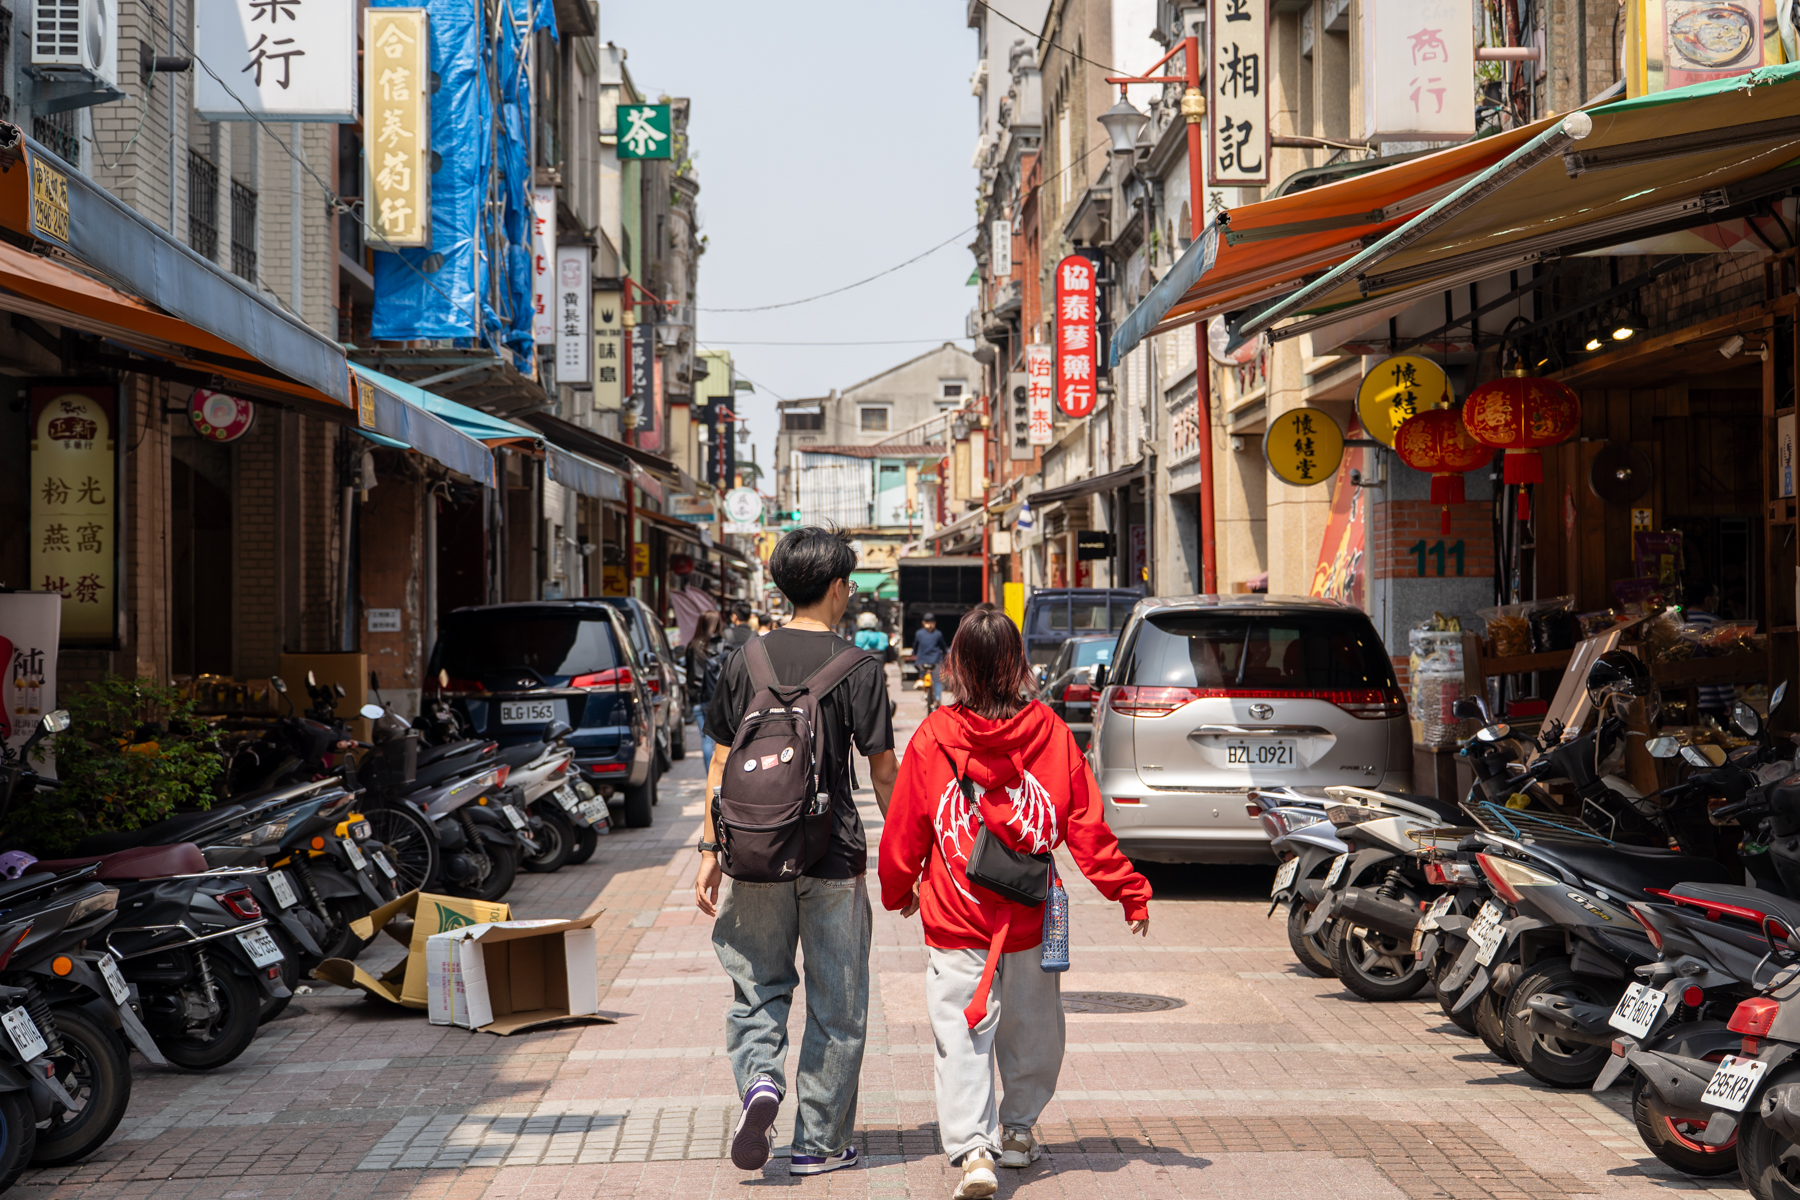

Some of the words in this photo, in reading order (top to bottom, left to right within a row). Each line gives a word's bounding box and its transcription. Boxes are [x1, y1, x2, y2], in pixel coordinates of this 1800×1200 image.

[620, 106, 668, 157] 茶
[599, 342, 617, 383] 味島
[1028, 355, 1052, 434] 怡和泰
[1292, 416, 1318, 480] 懷結堂
[41, 475, 106, 506] 粉光
[42, 522, 103, 554] 燕窩
[1409, 539, 1465, 576] 111
[501, 704, 554, 720] BLG-1563
[1228, 745, 1294, 764] BZL-0921
[1615, 993, 1658, 1027] NEY-8013
[1705, 1071, 1756, 1104] 295-KPA
